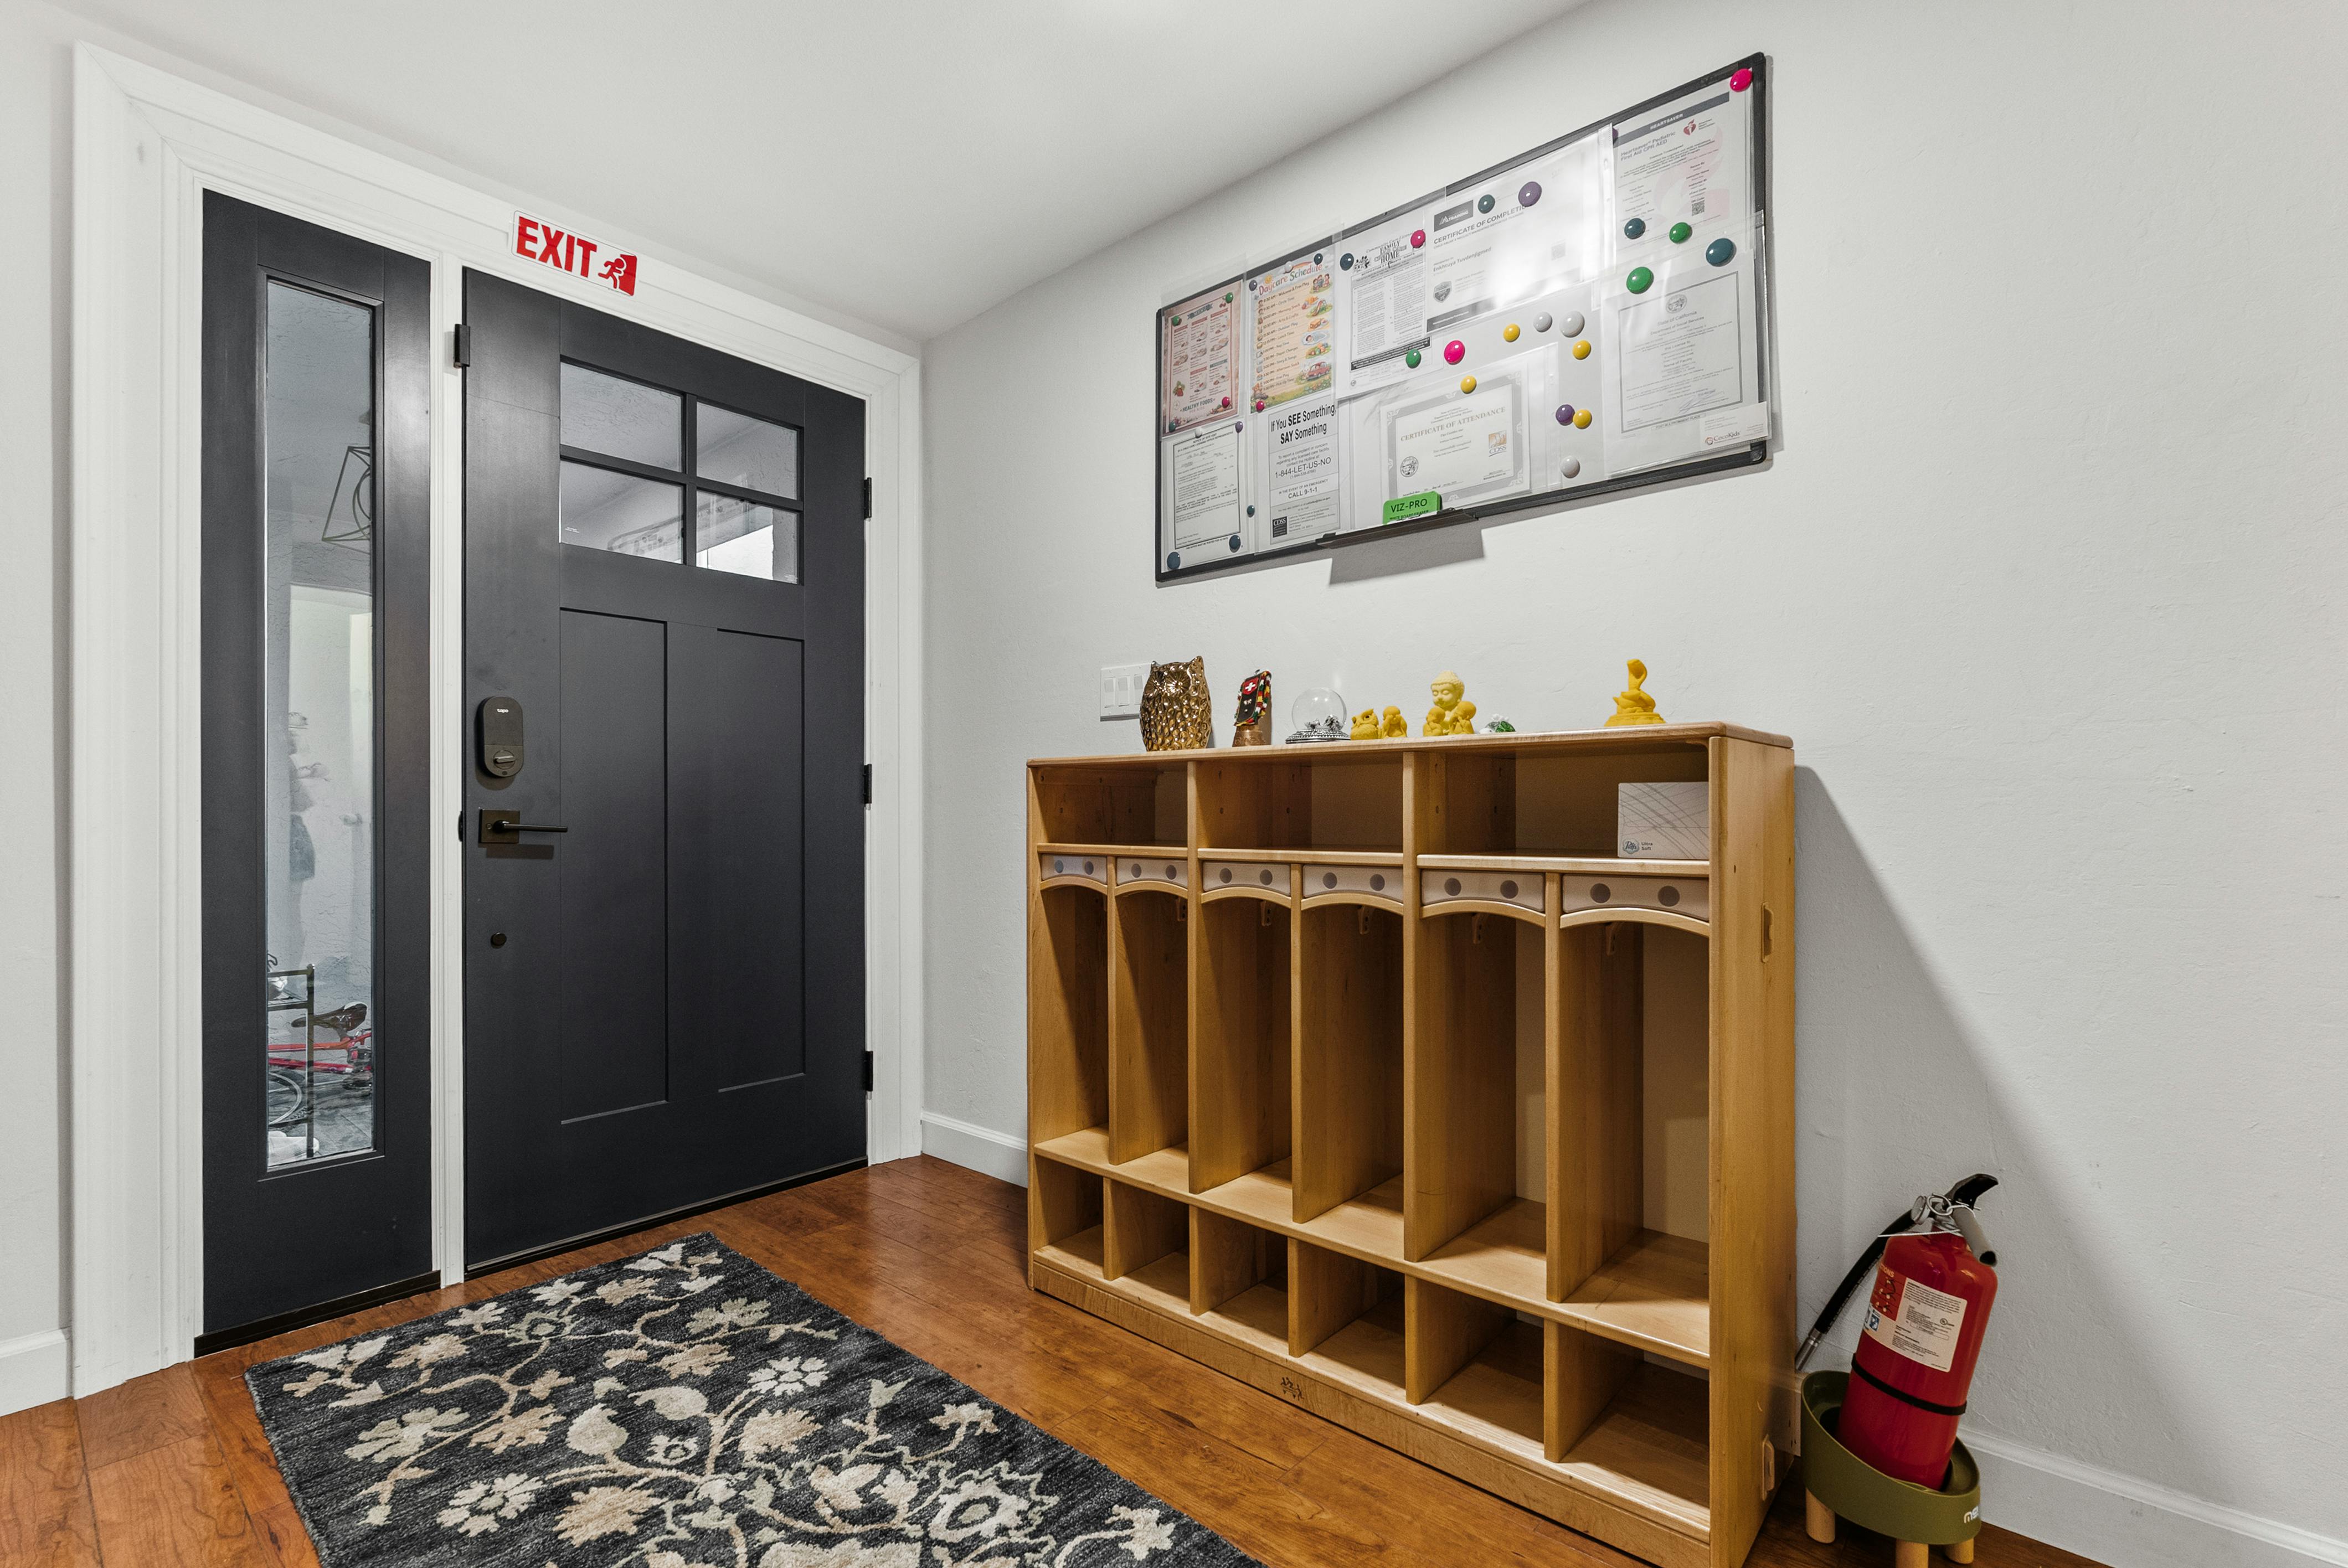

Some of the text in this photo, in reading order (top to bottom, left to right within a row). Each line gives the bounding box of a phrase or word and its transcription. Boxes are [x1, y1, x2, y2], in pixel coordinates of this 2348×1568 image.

[1650, 114, 1683, 129] HEARTSAVER
[1434, 224, 1475, 244] CERTIFICATE
[1476, 219, 1485, 228] OF
[517, 216, 597, 278] EXIT
[1259, 264, 1322, 295] Daycare Schedule
[1182, 397, 1213, 412] HEALTHY FOODS
[1270, 404, 1336, 432] If You SEE Something,
[1400, 425, 1444, 441] CERTIFICATE
[1457, 407, 1505, 425] ATTENDANCE
[1280, 423, 1327, 445] SAY Something
[1275, 457, 1331, 477] 1-844-LET-US-NO
[1288, 486, 1317, 498] CALL 9-1-1
[1391, 498, 1427, 513] VIZ-PRO
